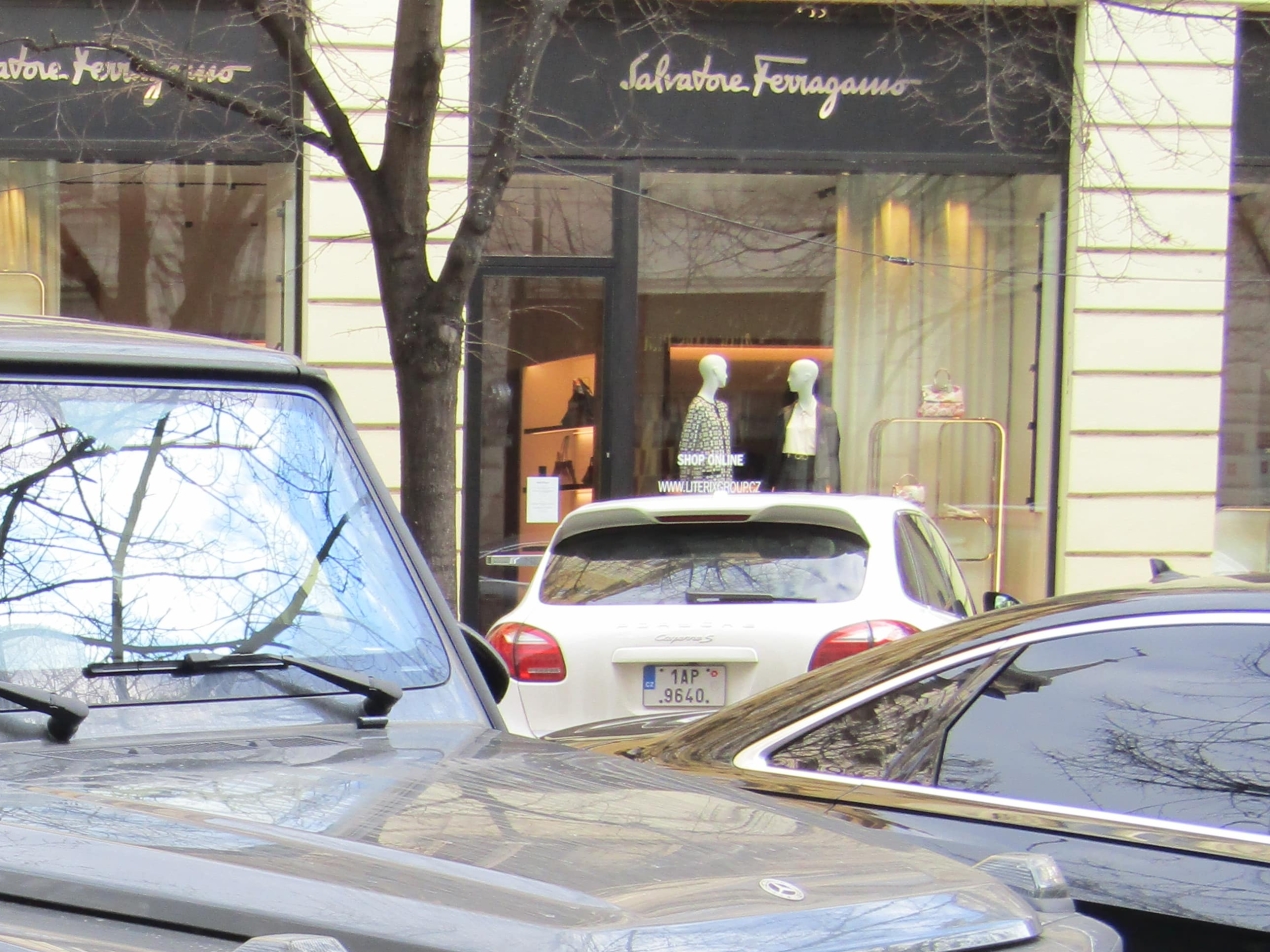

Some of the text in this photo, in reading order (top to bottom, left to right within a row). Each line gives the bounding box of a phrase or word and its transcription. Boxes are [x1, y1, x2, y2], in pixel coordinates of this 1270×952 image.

[620, 53, 922, 119] Salvatore Ferragamo
[677, 453, 744, 467] SHOP ONLINE
[671, 669, 700, 685] 1AP
[663, 687, 705, 704] 9640
